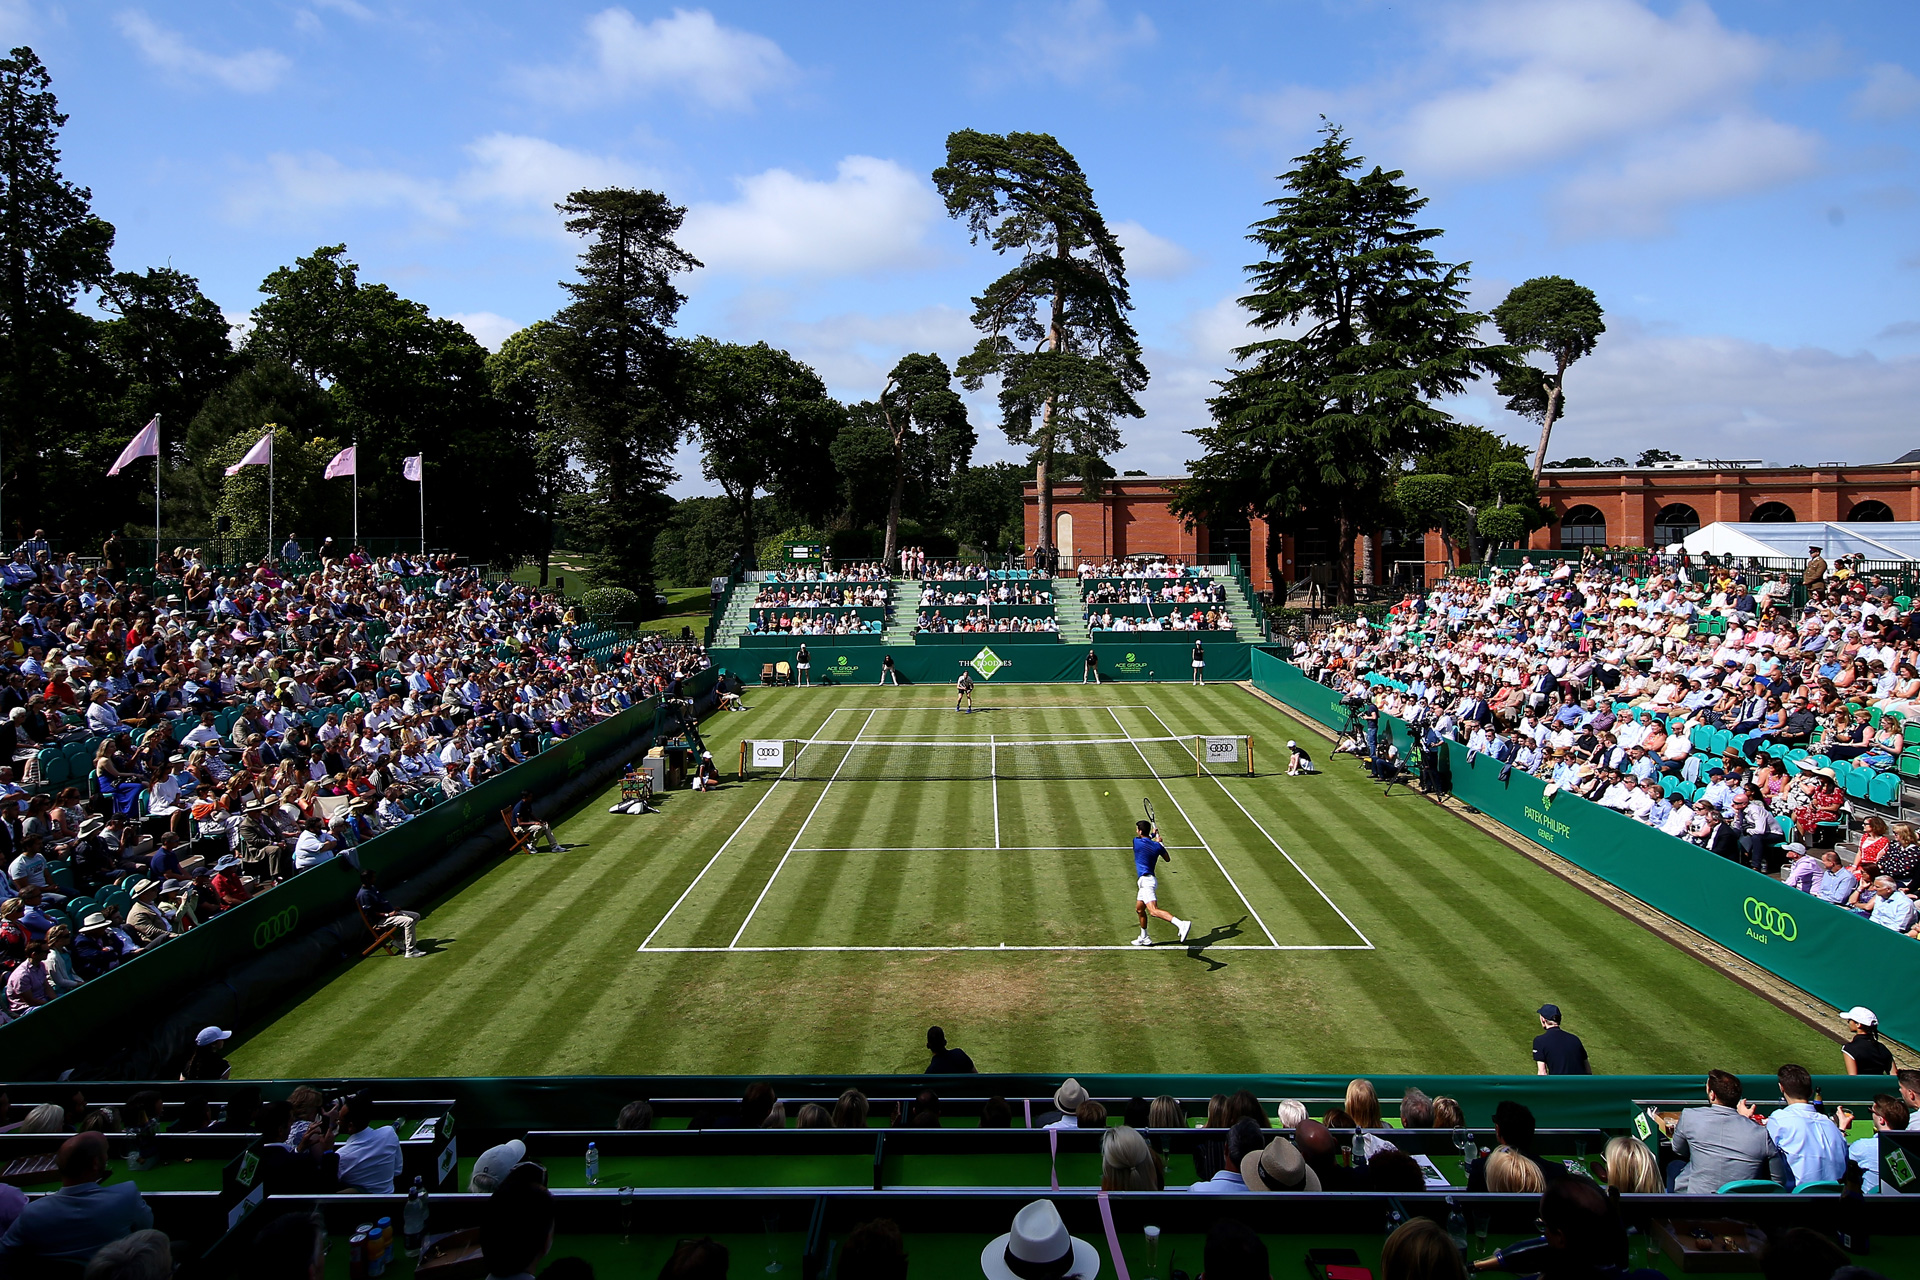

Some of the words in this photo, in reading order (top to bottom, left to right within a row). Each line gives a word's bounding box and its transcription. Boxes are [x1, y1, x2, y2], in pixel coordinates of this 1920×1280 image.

[1524, 805, 1543, 825] PATEK
[1543, 814, 1571, 839] PHILIPPE
[1745, 927, 1768, 945] Audi
